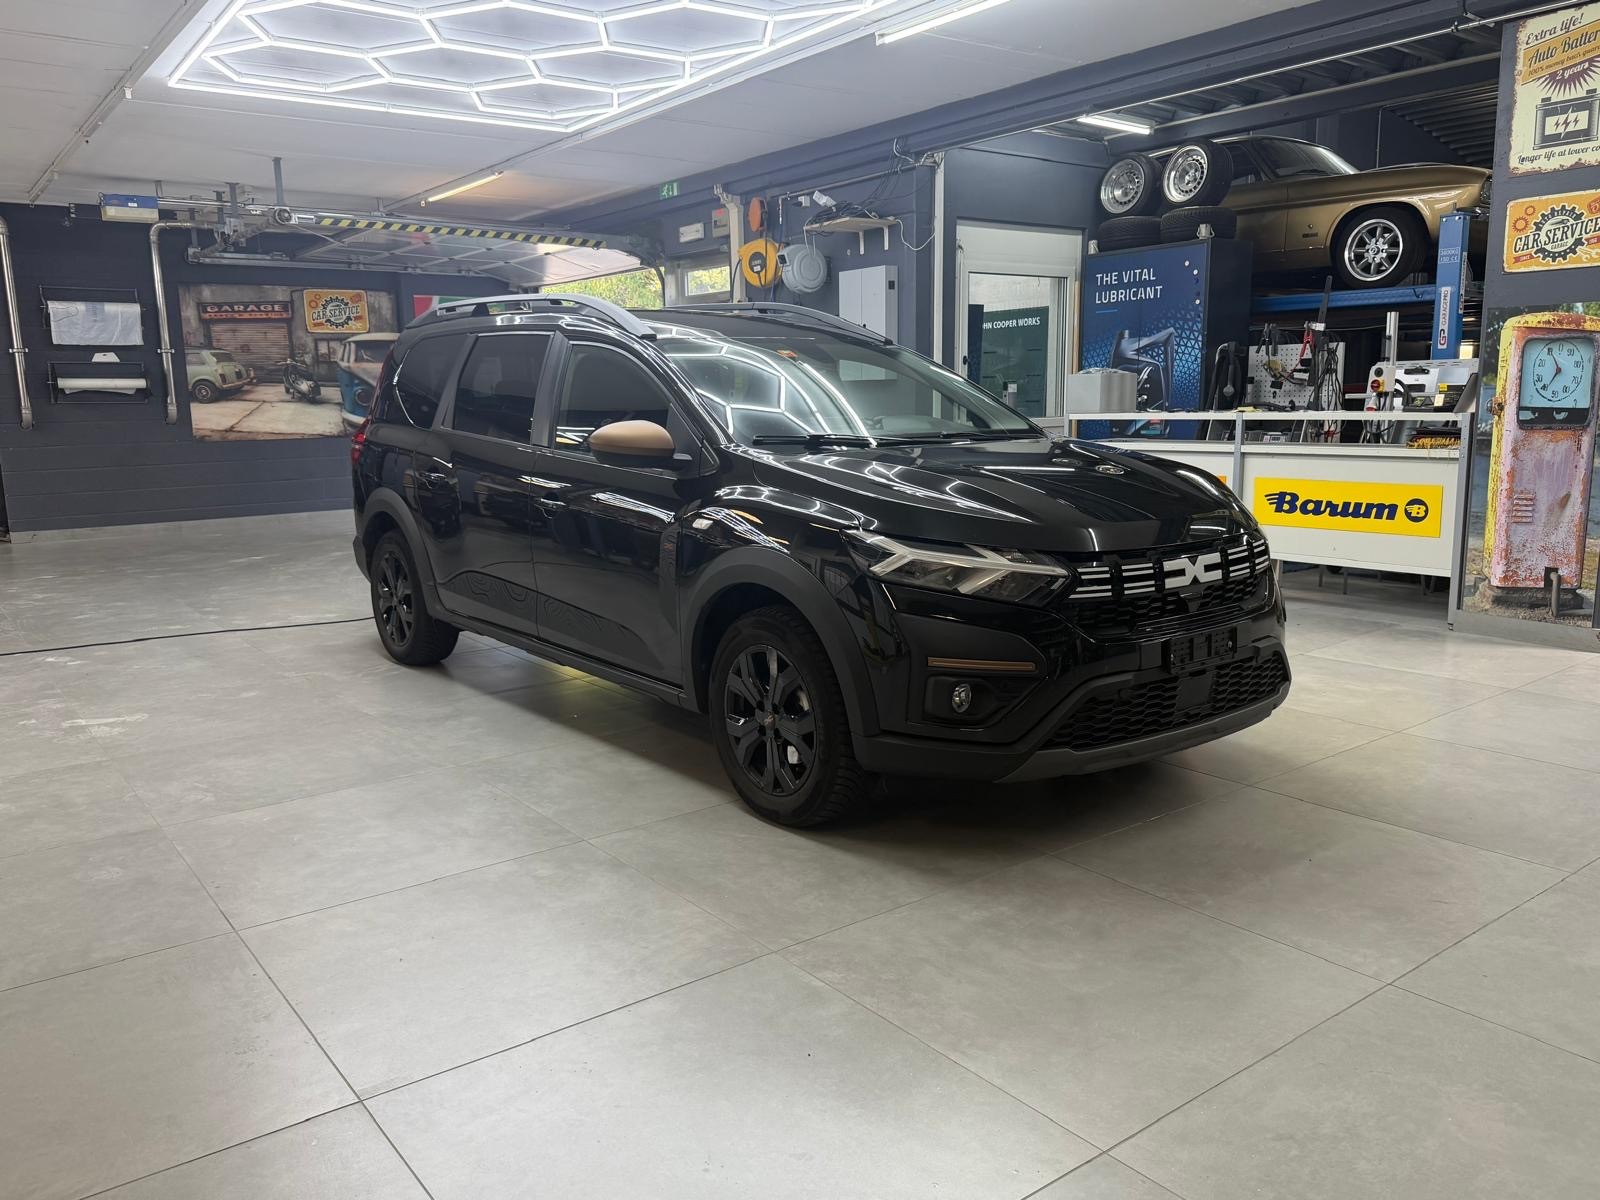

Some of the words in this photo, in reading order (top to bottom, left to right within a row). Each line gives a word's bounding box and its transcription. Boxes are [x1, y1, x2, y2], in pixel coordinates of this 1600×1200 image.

[1526, 25, 1557, 45] Extra
[1560, 12, 1584, 32] life!
[1528, 45, 1558, 68] Auto
[1556, 70, 1563, 80] 2
[1563, 61, 1590, 79] years
[1543, 150, 1557, 161] life
[1557, 148, 1566, 157] at
[1567, 146, 1591, 156] lower
[1513, 232, 1541, 253] CAR
[1543, 217, 1600, 246] SERVICE
[1095, 272, 1118, 286] THE
[1122, 268, 1156, 283] VITAL
[1095, 286, 1163, 304] LUBRICANT
[206, 304, 286, 312] GARAGE
[311, 310, 327, 322] CAR
[328, 305, 360, 319] SERVICE
[993, 319, 1017, 329] COOPER
[1018, 317, 1041, 327] WORKS
[1551, 390, 1559, 398] 50
[1264, 491, 1399, 521] Barum
